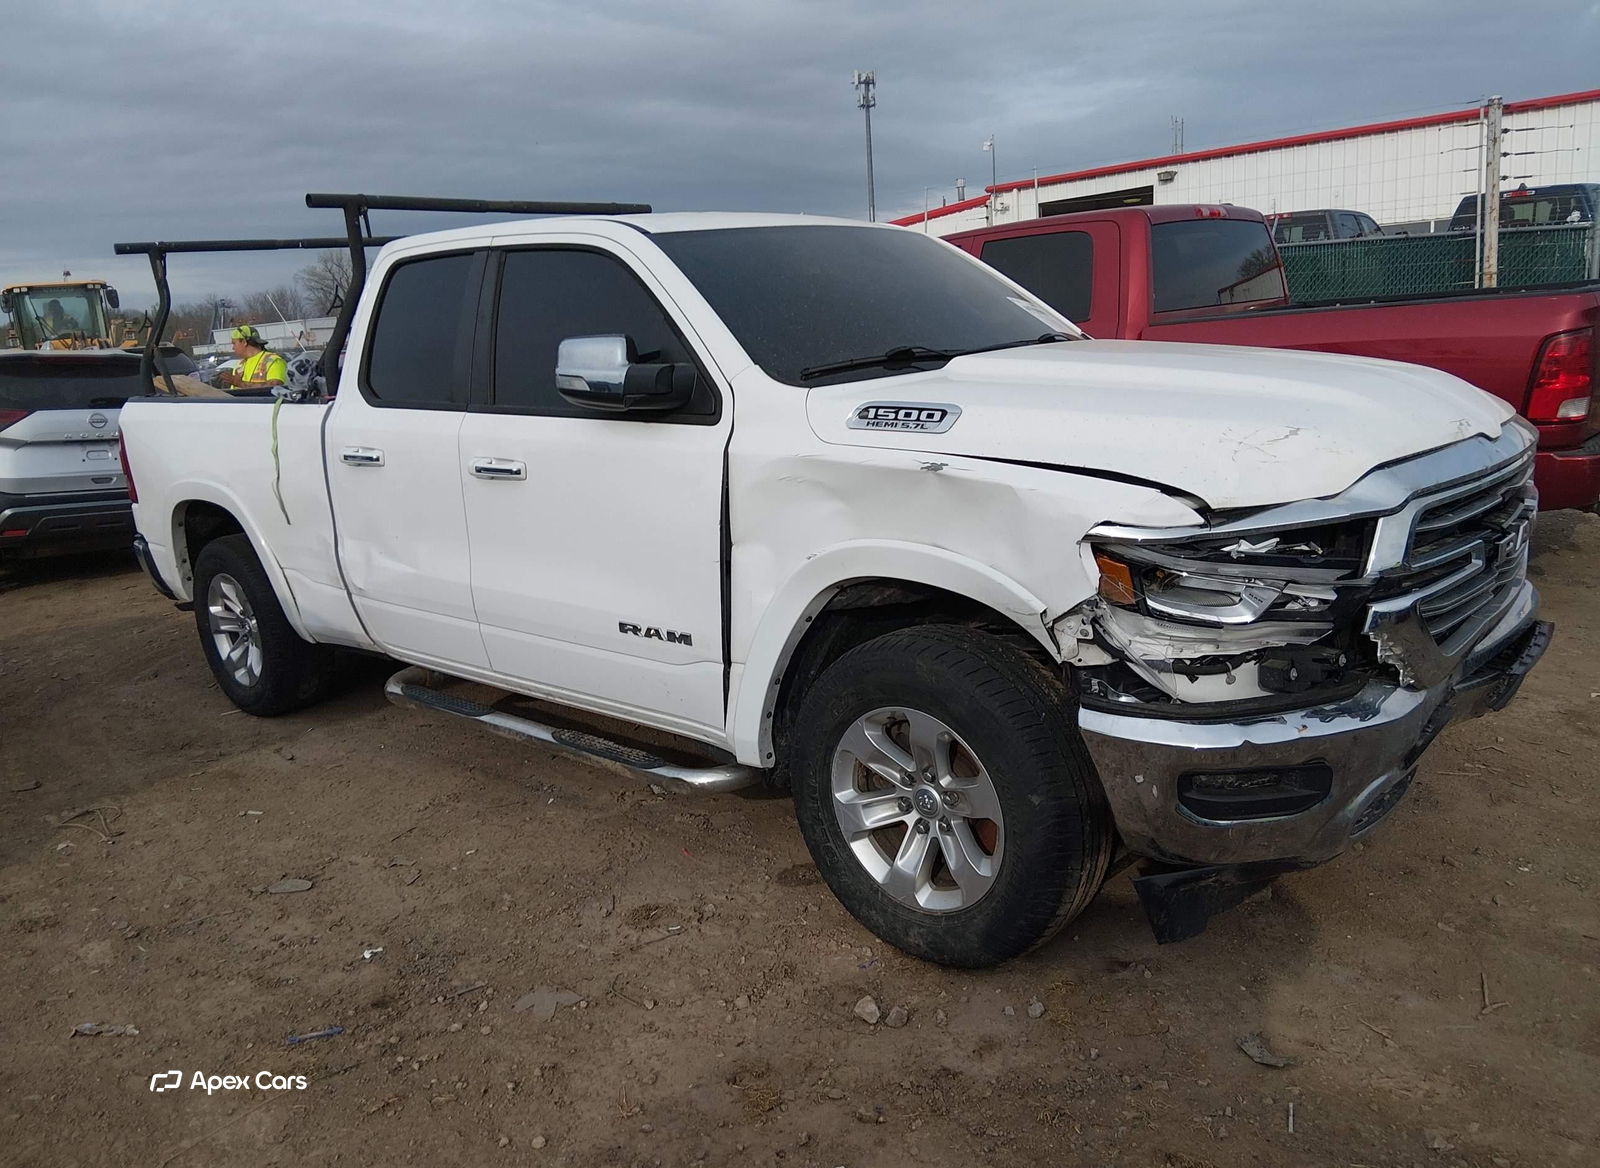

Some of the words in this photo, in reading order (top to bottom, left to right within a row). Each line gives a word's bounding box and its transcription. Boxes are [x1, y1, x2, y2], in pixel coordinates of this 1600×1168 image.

[867, 407, 942, 422] 1500
[866, 420, 898, 428] HEMI
[900, 422, 929, 430] 5.7L
[618, 620, 693, 647] RAM
